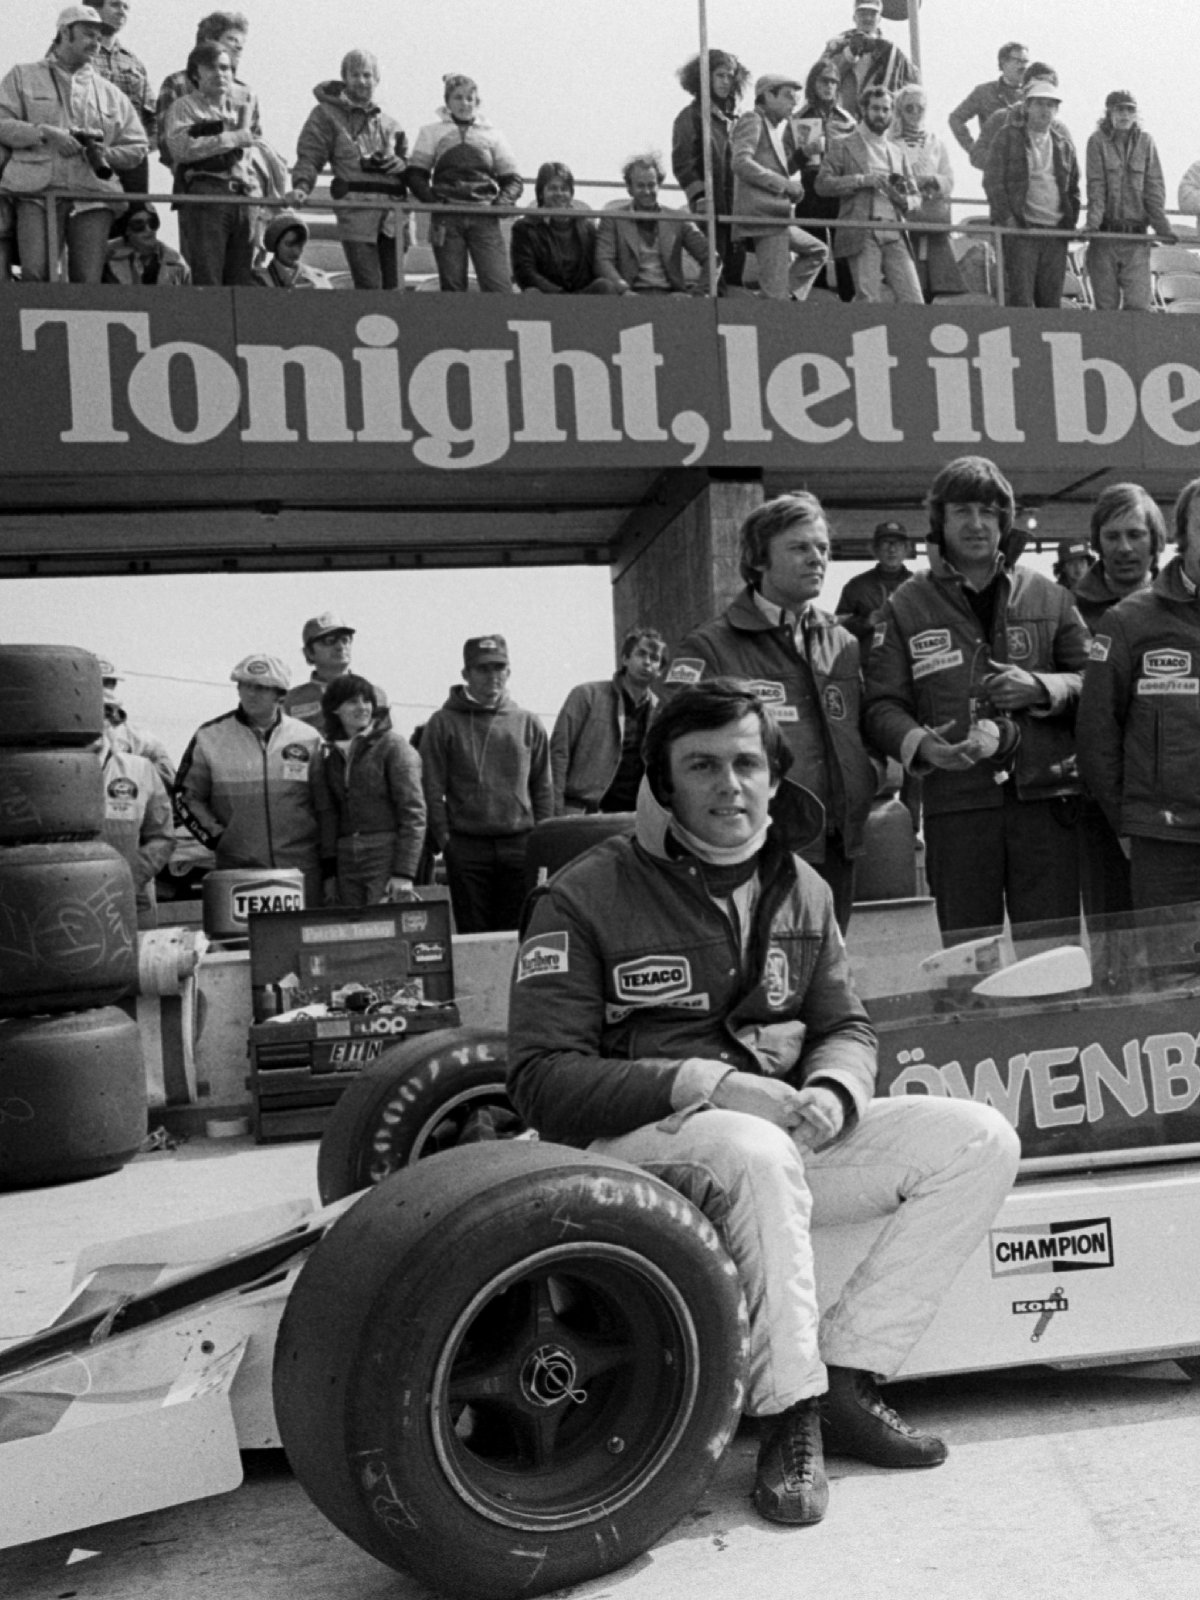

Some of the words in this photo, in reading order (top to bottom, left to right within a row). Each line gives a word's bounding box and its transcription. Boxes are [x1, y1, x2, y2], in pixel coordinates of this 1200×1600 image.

[20, 308, 710, 469] Tonight,
[717, 323, 904, 445] let
[928, 323, 1026, 444] it
[1149, 657, 1187, 667] TEXACO
[235, 893, 301, 913] TEXACO
[622, 968, 683, 987] TEXACO
[995, 1232, 1106, 1263] CHAMPION
[1015, 1300, 1066, 1312] KONI
